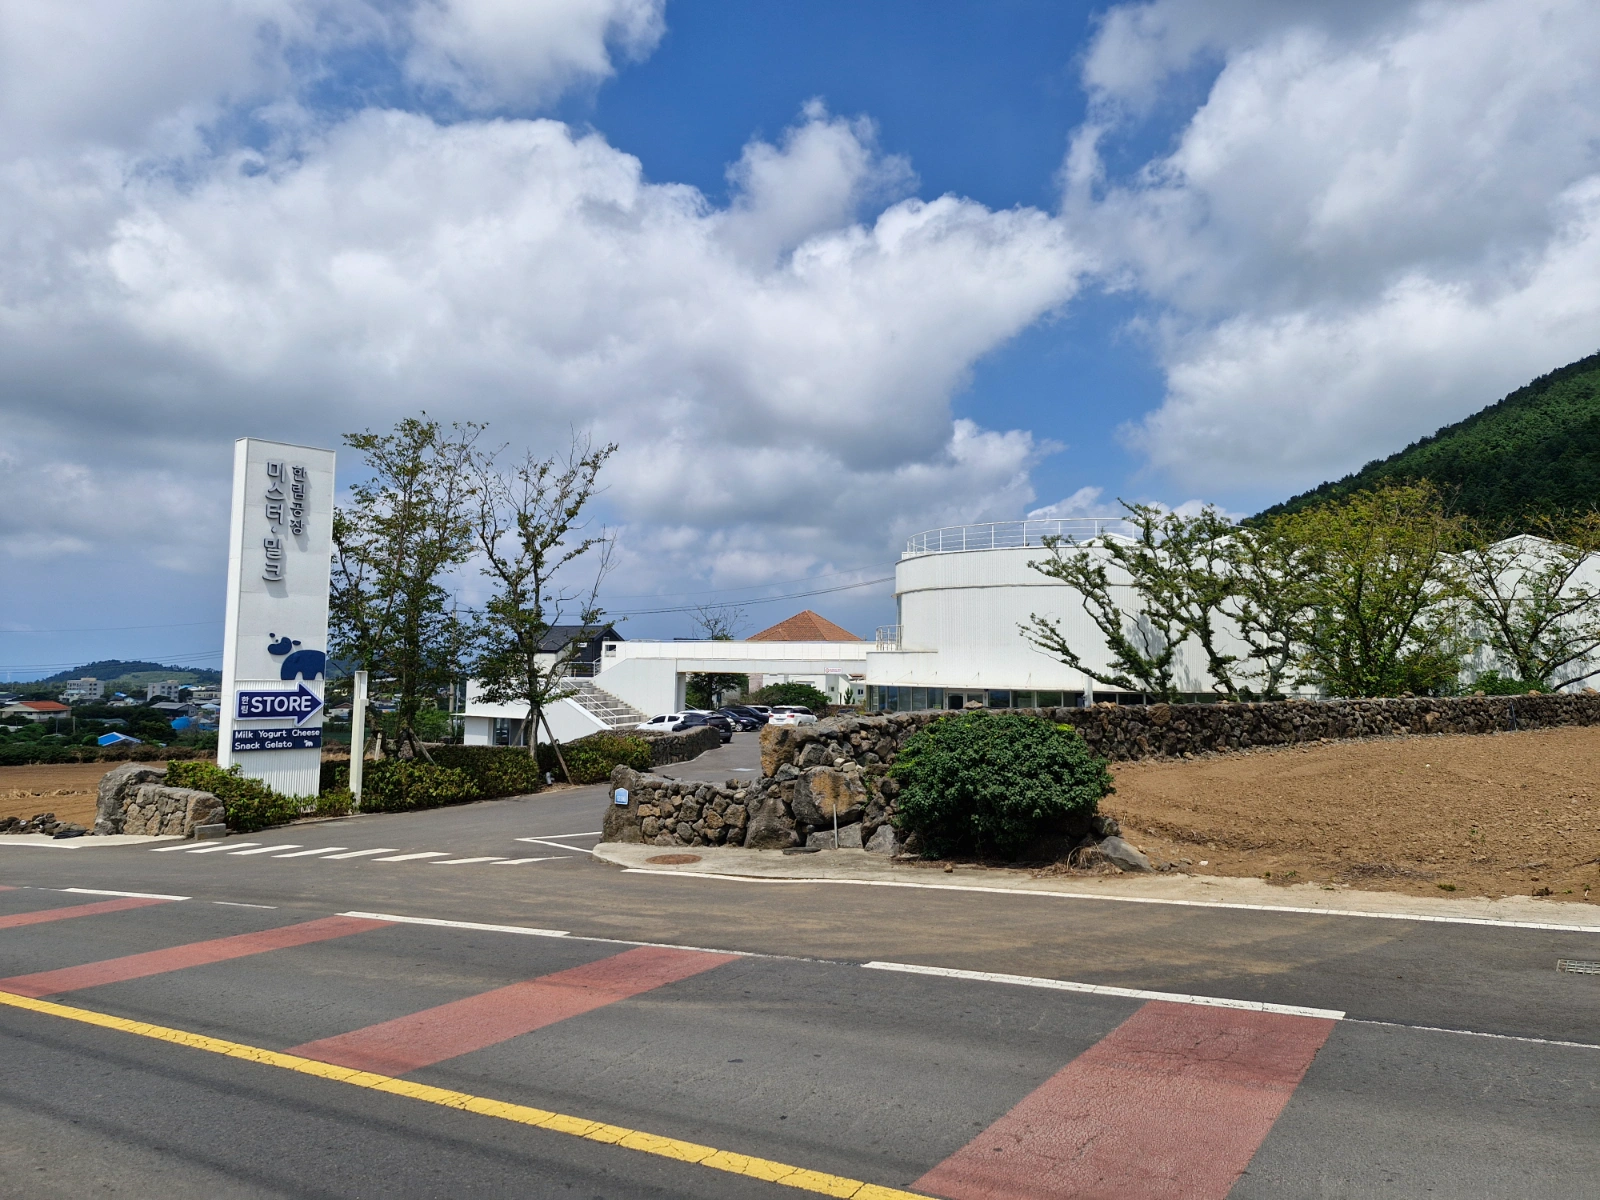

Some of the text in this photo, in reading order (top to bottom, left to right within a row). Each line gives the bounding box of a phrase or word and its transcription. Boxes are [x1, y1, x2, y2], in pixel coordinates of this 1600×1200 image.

[290, 466, 307, 535] 한림공장
[251, 696, 311, 712] STORE
[235, 729, 320, 739] Milk Yogurt Cheese
[235, 741, 292, 750] Snack Gelato
